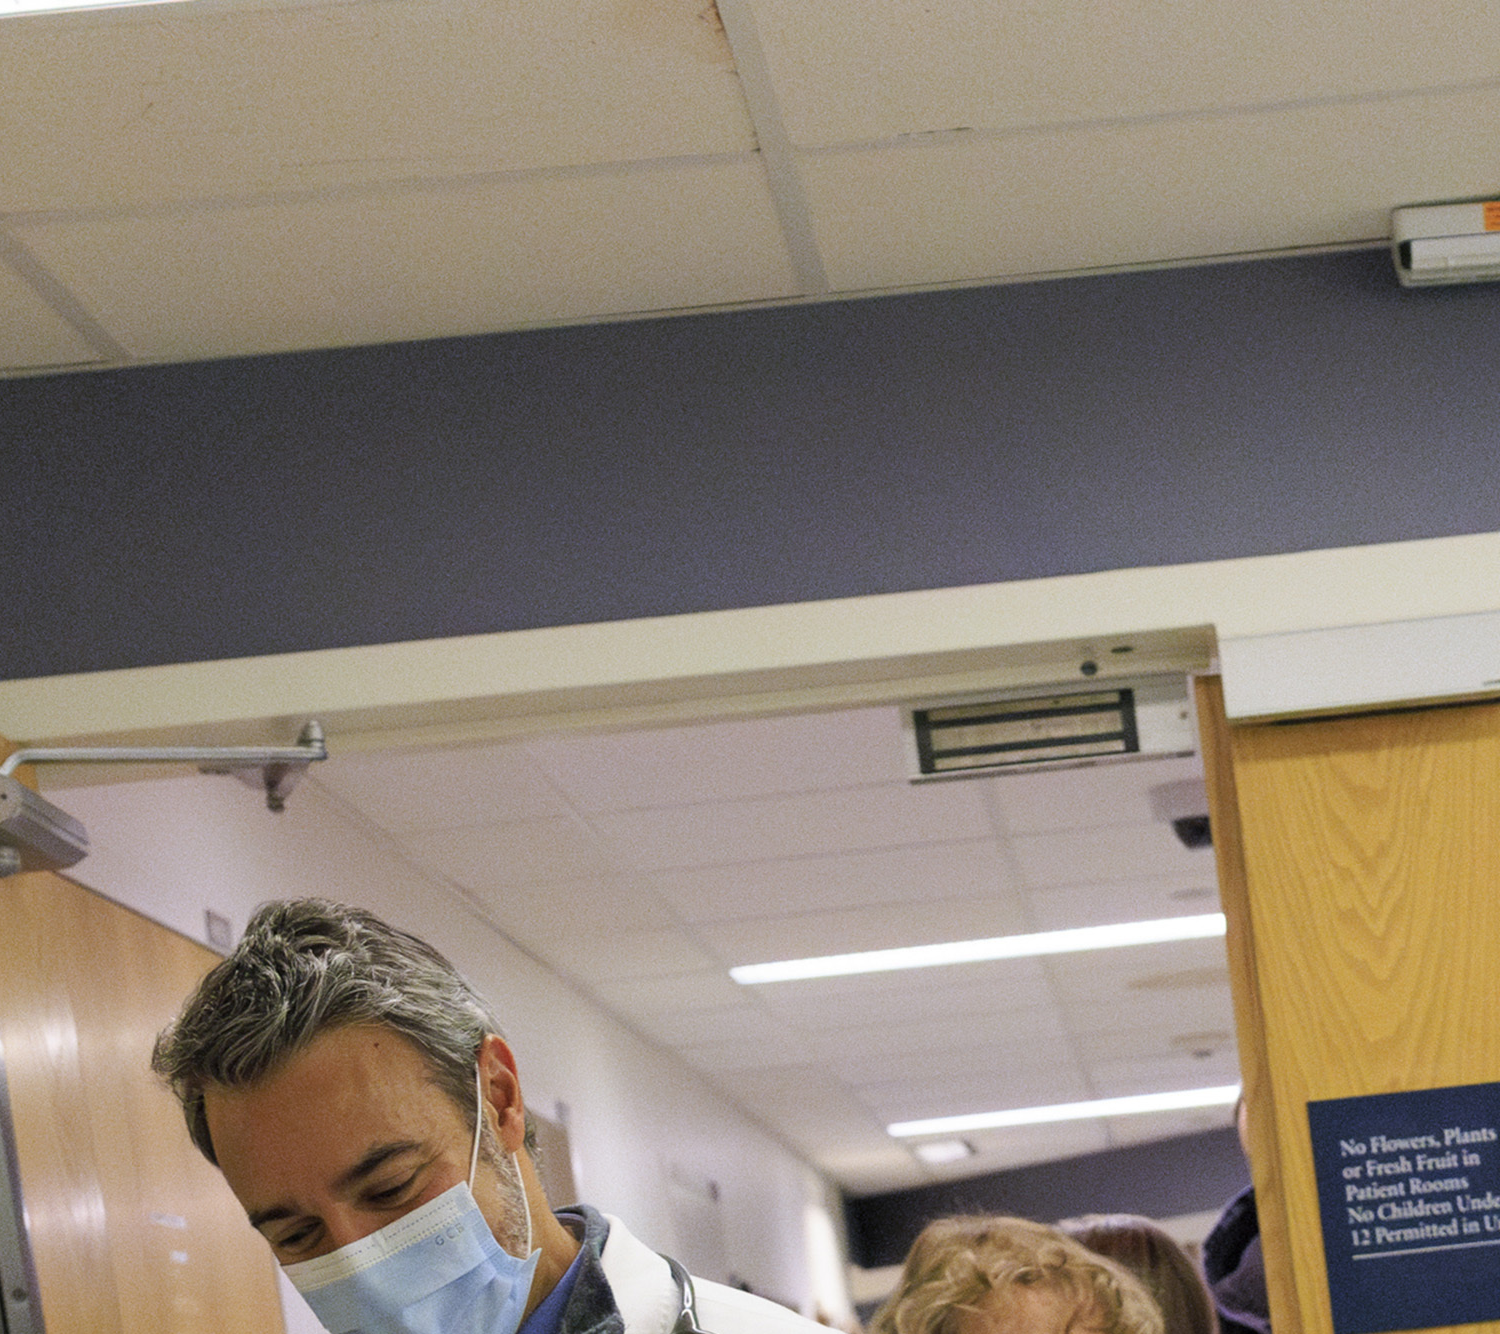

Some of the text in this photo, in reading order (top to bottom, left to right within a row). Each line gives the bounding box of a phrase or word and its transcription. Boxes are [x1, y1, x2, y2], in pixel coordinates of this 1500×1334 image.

[1340, 1126, 1498, 1157] No Flowers, Plants
[1342, 1149, 1481, 1179] or Fresh Fruit in
[1345, 1176, 1469, 1202] Patient Rooms
[1347, 1206, 1375, 1224] No
[1377, 1199, 1453, 1221] Children
[1352, 1229, 1371, 1246] 12
[1375, 1218, 1459, 1245] Permitted
[1462, 1217, 1481, 1234] in
